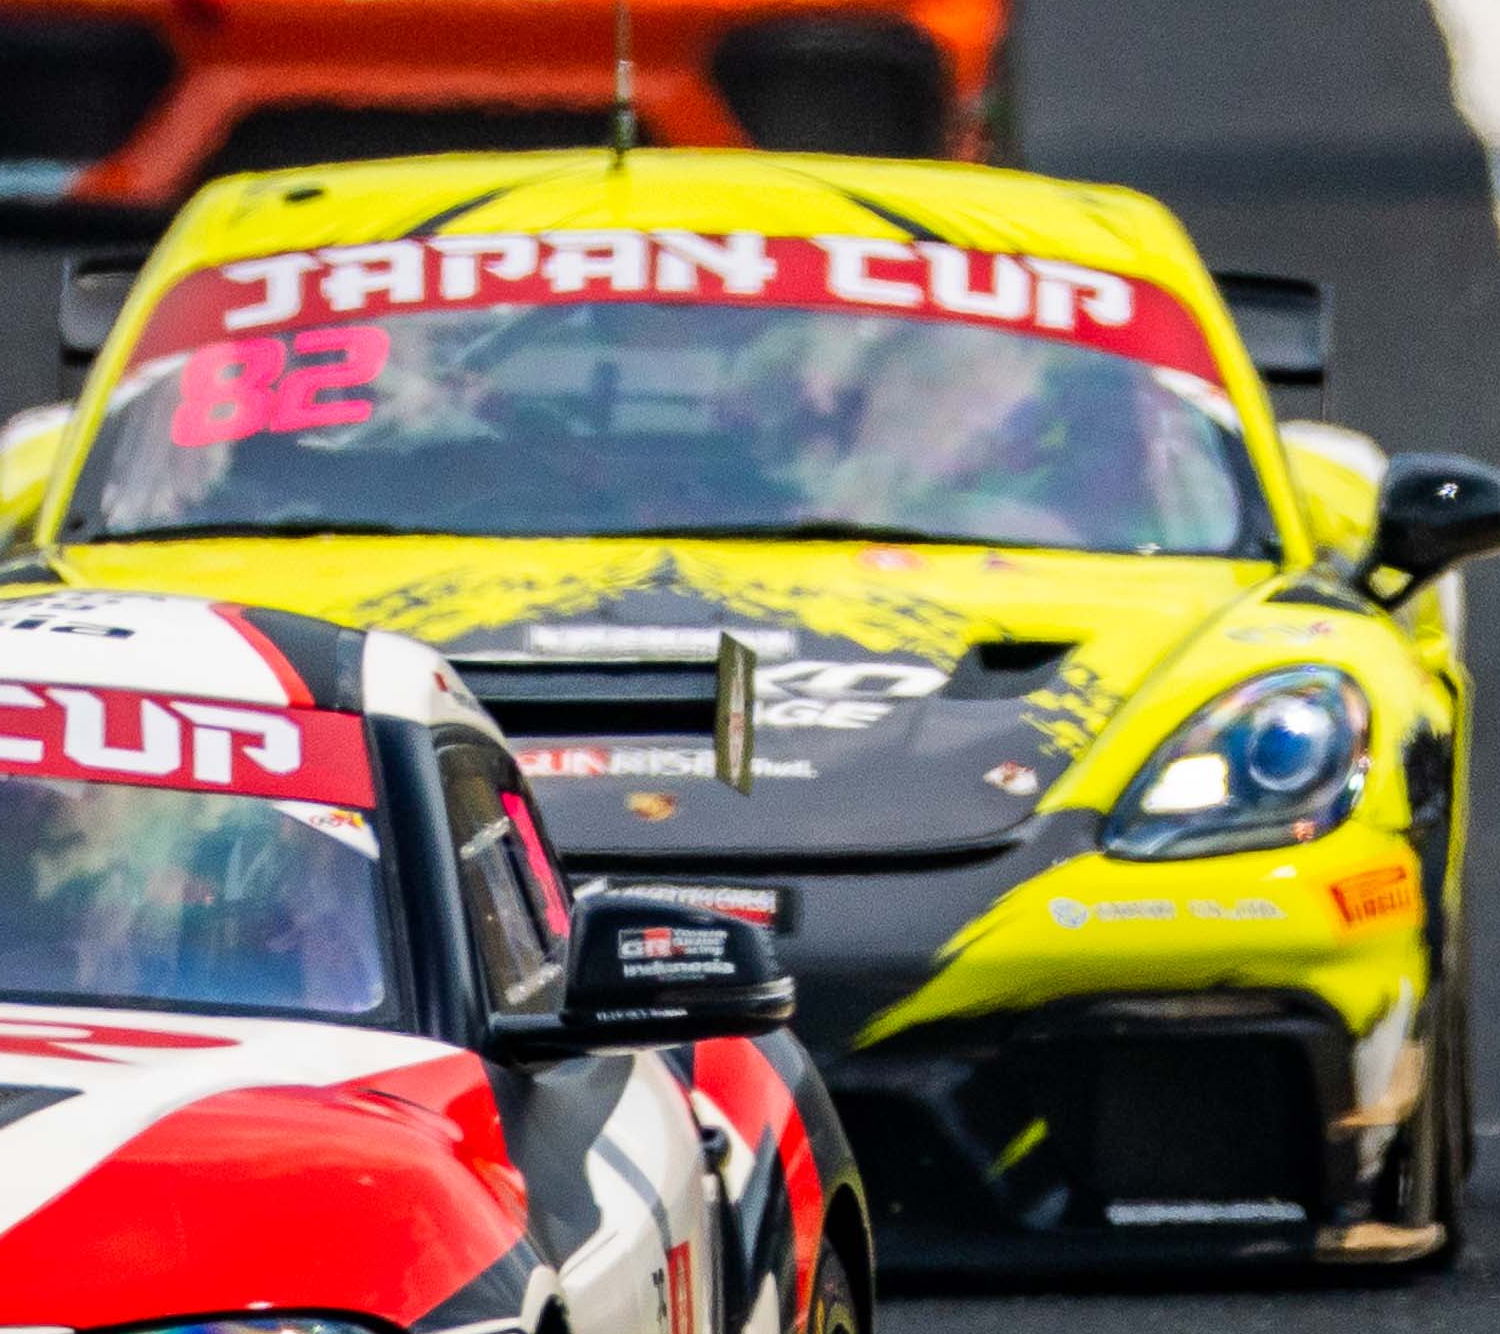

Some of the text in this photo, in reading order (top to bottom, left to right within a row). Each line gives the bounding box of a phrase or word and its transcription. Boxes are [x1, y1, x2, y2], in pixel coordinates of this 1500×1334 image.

[223, 229, 1134, 330] JAPAN CUP
[171, 325, 390, 448] 82
